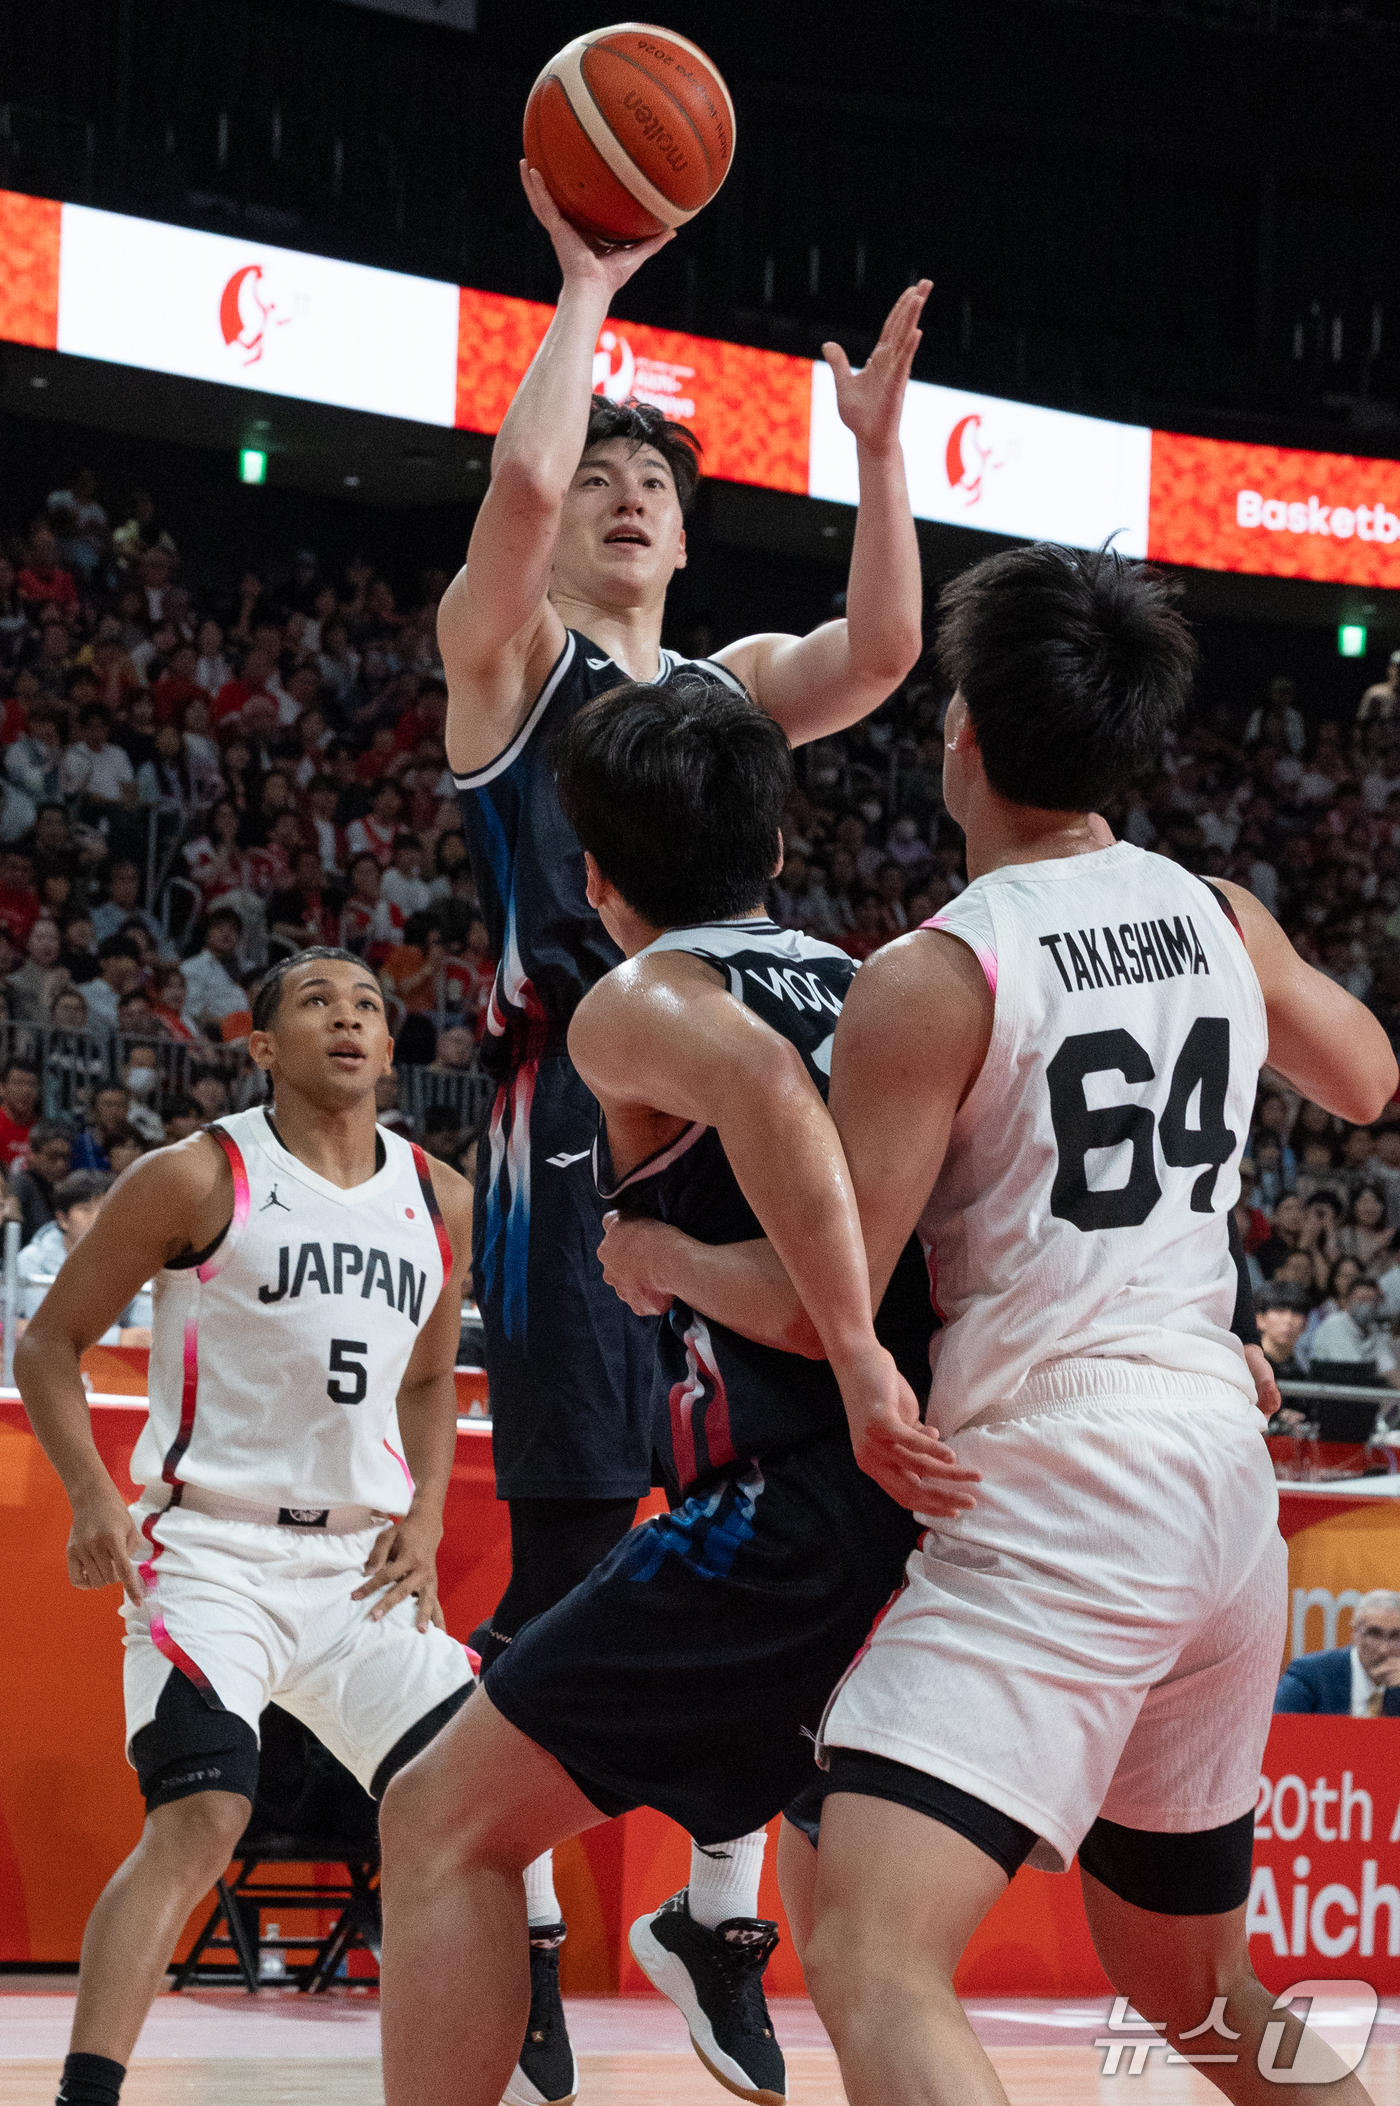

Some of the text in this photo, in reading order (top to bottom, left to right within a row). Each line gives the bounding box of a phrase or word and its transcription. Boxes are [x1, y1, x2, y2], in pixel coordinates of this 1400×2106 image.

[637, 41, 675, 66] 2026
[622, 89, 689, 173] molten
[1236, 489, 1400, 544] Basketb
[1038, 914, 1210, 993] TAKASHIMA
[1046, 1016, 1237, 1232] 64
[258, 1242, 427, 1327] JAPAN
[326, 1338, 368, 1405] 5
[1253, 1770, 1373, 1842] 20th
